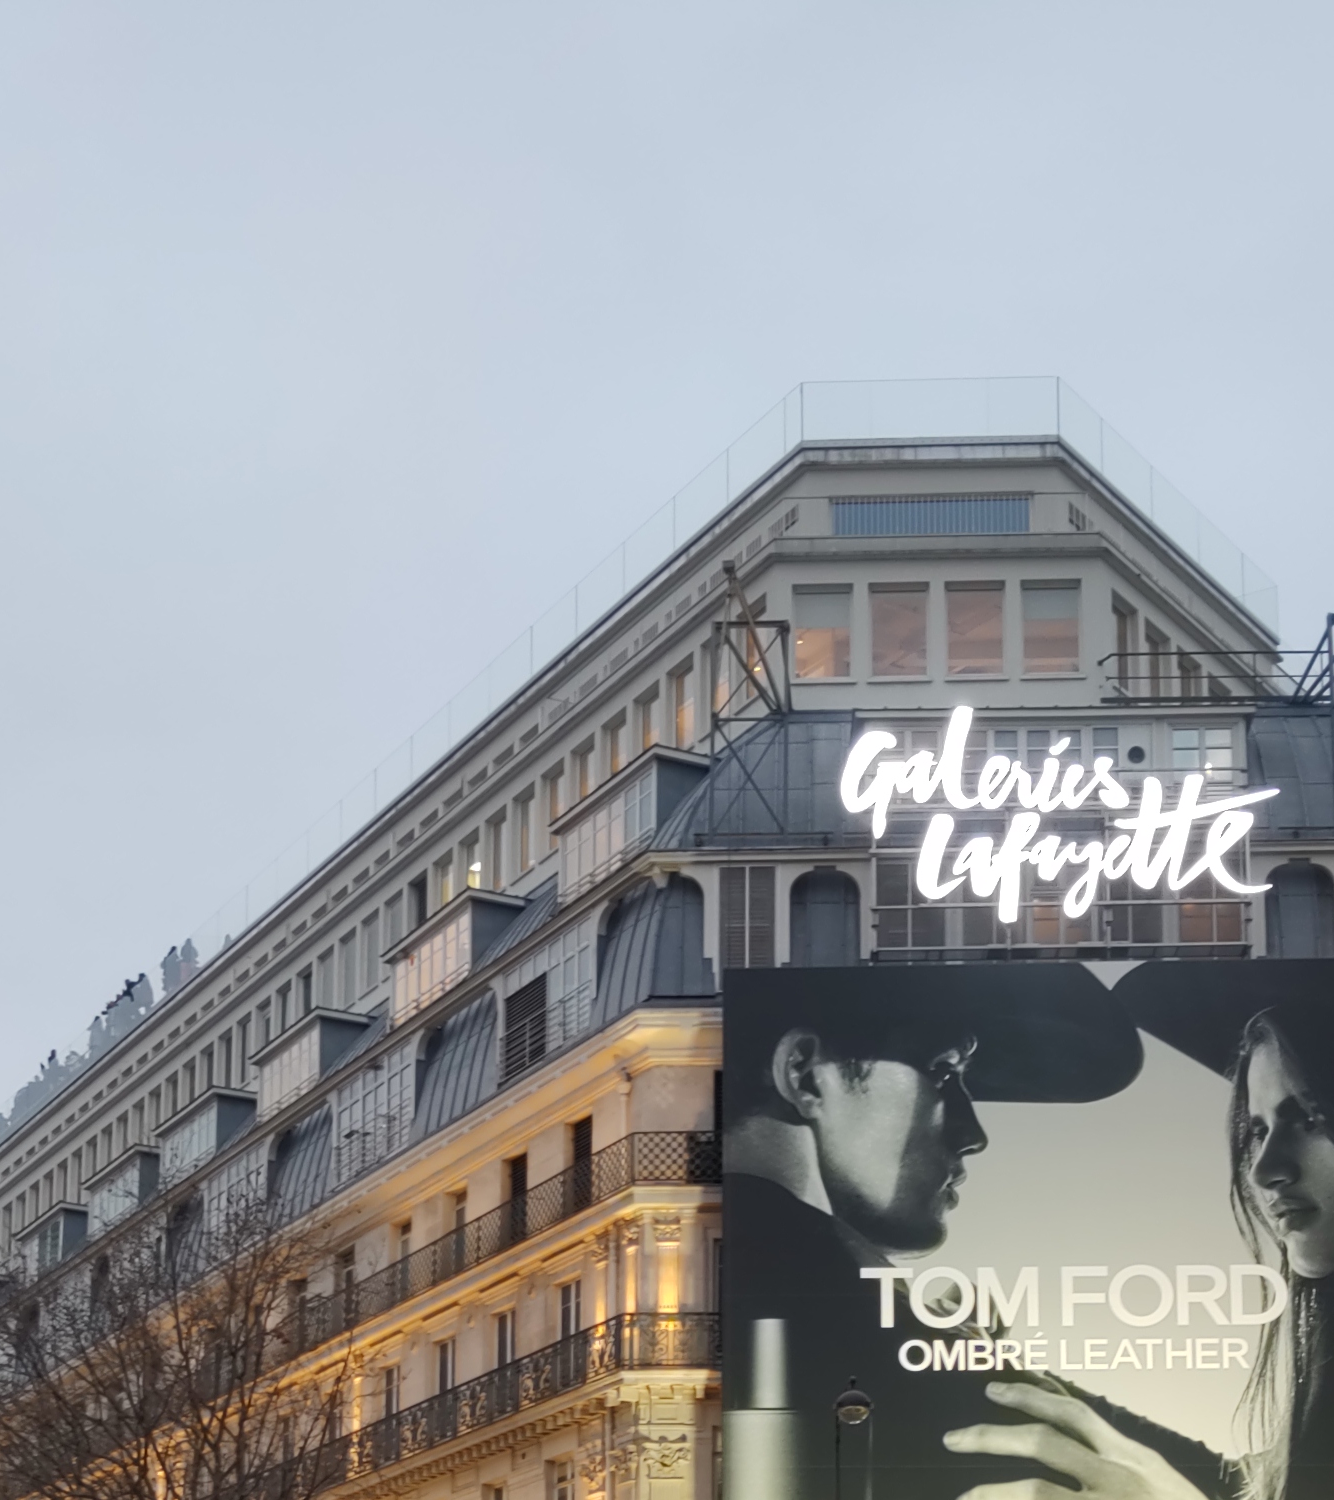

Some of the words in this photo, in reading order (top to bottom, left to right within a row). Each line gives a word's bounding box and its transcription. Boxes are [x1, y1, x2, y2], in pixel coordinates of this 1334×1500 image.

[840, 705, 1130, 839] Galeries
[916, 774, 1280, 924] Lafayette
[860, 1266, 1039, 1328] TOM
[1061, 1264, 1288, 1327] FORD
[898, 1332, 1048, 1371] OMBRÉ
[1060, 1338, 1250, 1370] LEATHER
